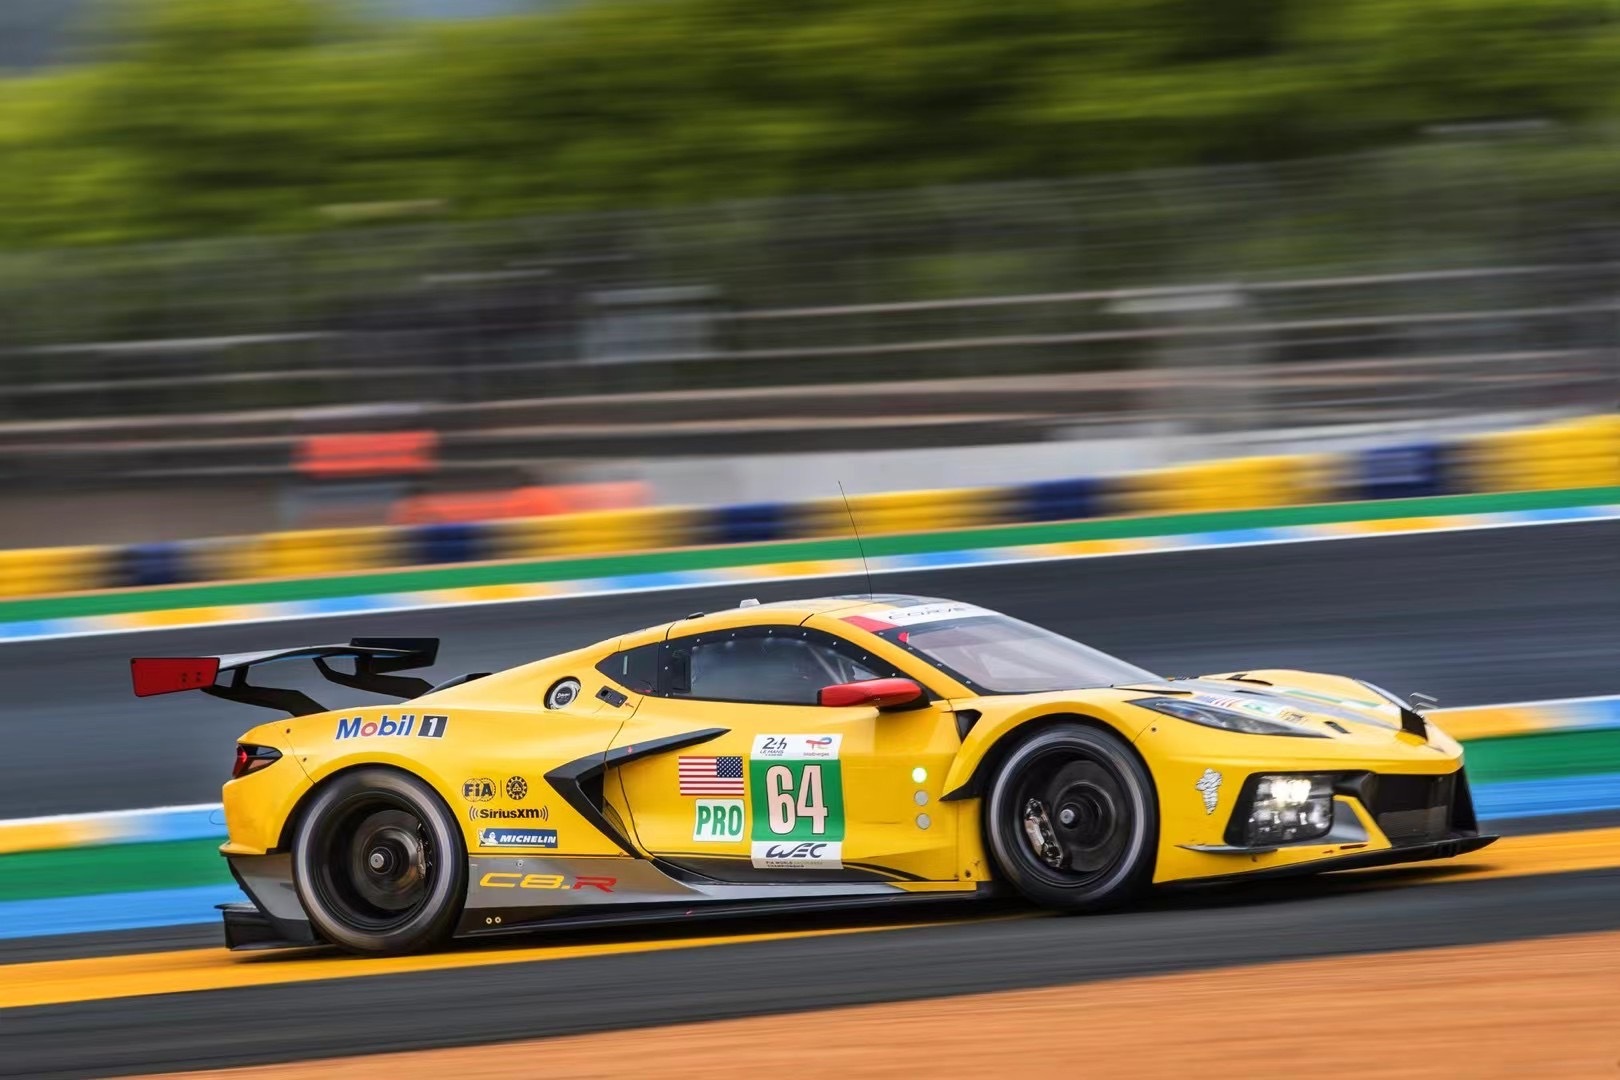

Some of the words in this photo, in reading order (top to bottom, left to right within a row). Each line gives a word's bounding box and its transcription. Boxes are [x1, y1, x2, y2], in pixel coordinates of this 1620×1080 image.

[336, 715, 414, 740] Mobil
[766, 764, 828, 835] 64
[696, 804, 743, 837] PRO
[500, 835, 556, 844] MICHELIN
[766, 842, 828, 858] WEC
[479, 872, 617, 893] C8.R
